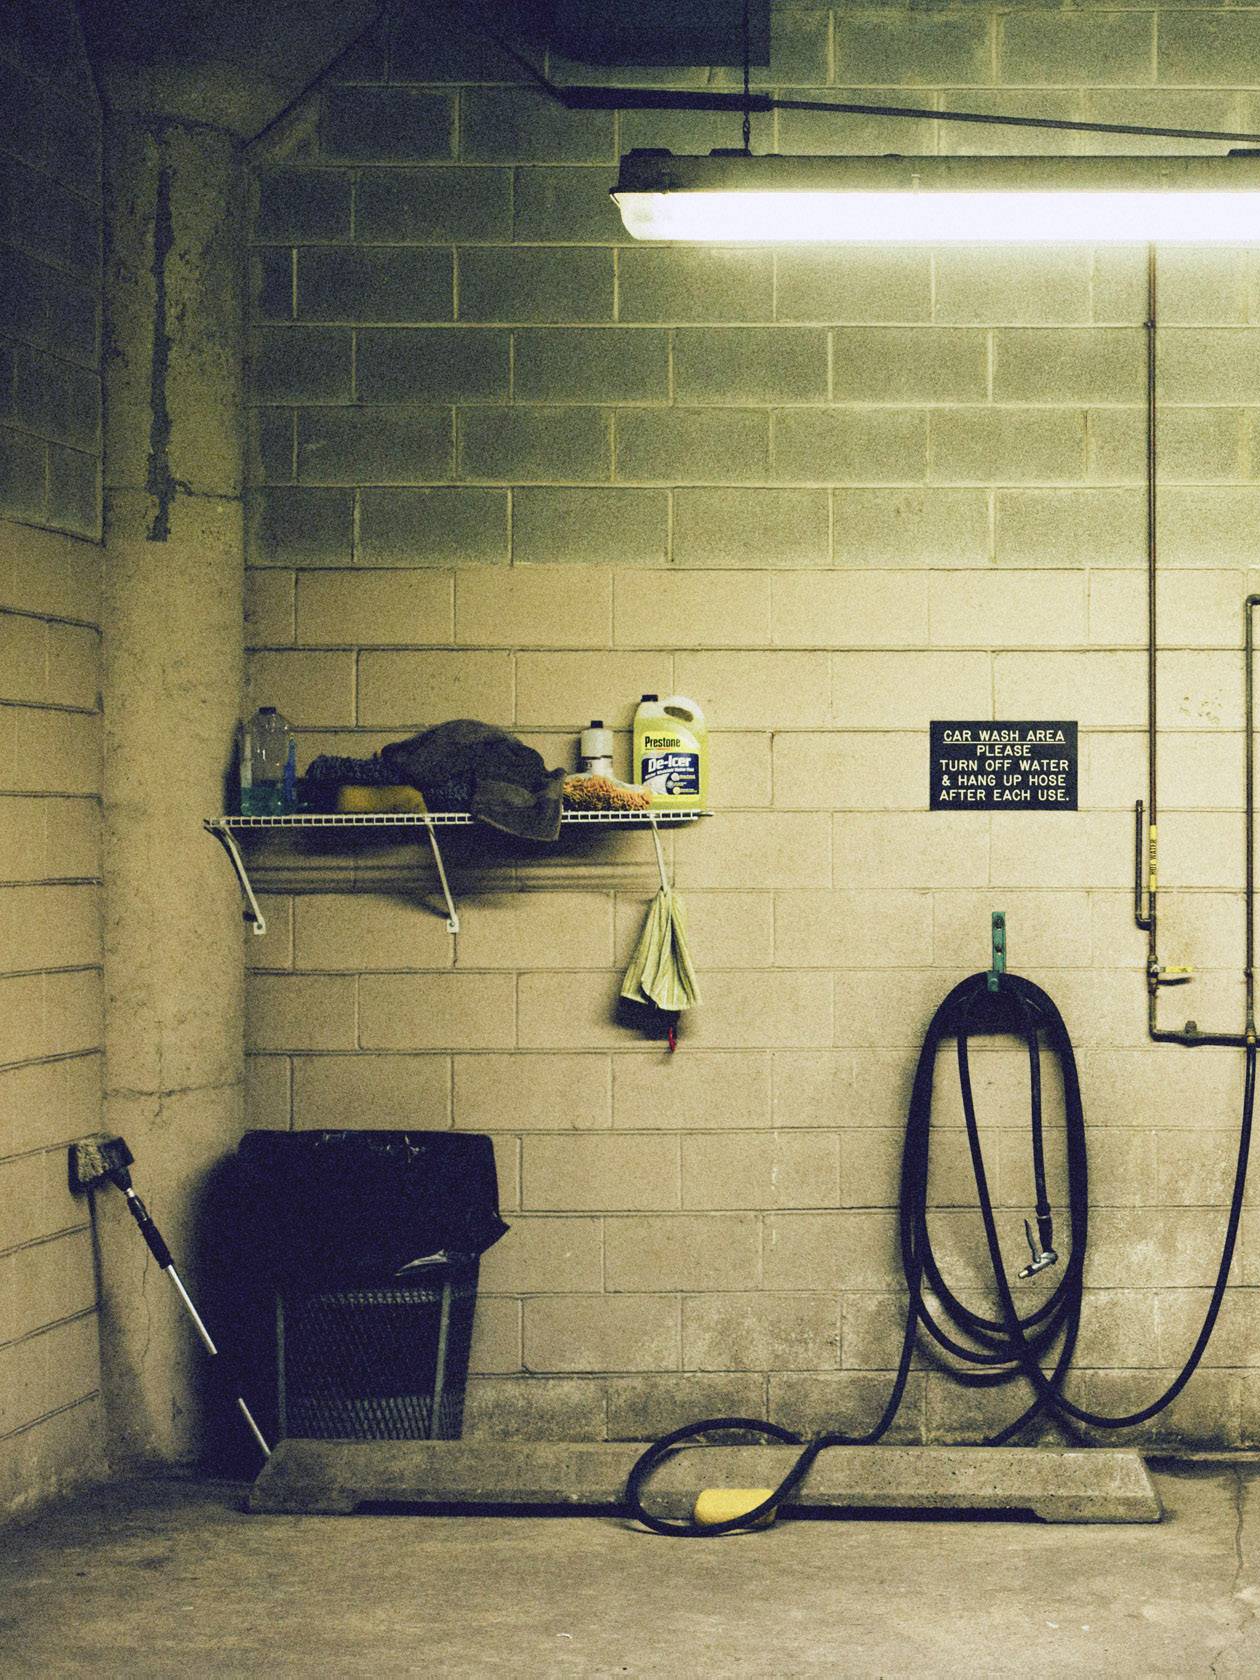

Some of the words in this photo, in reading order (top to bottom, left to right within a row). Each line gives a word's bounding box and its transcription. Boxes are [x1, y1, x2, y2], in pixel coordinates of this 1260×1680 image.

[943, 730, 972, 741] CAR
[979, 730, 1019, 741] WASH
[1026, 730, 1065, 741] AREA
[645, 736, 681, 748] Prestone
[976, 745, 1031, 757] PLEASE
[648, 755, 692, 773] De-Icer
[940, 760, 978, 771] TURN
[985, 760, 1012, 771] OFF
[1019, 760, 1069, 771] WATER
[941, 775, 951, 786] &
[958, 775, 996, 786] HANG
[1003, 775, 1022, 786] UP
[1029, 775, 1066, 786] HOSE
[939, 790, 986, 801] AFTER
[993, 790, 1031, 801] EACH
[1038, 790, 1069, 801] USE.
